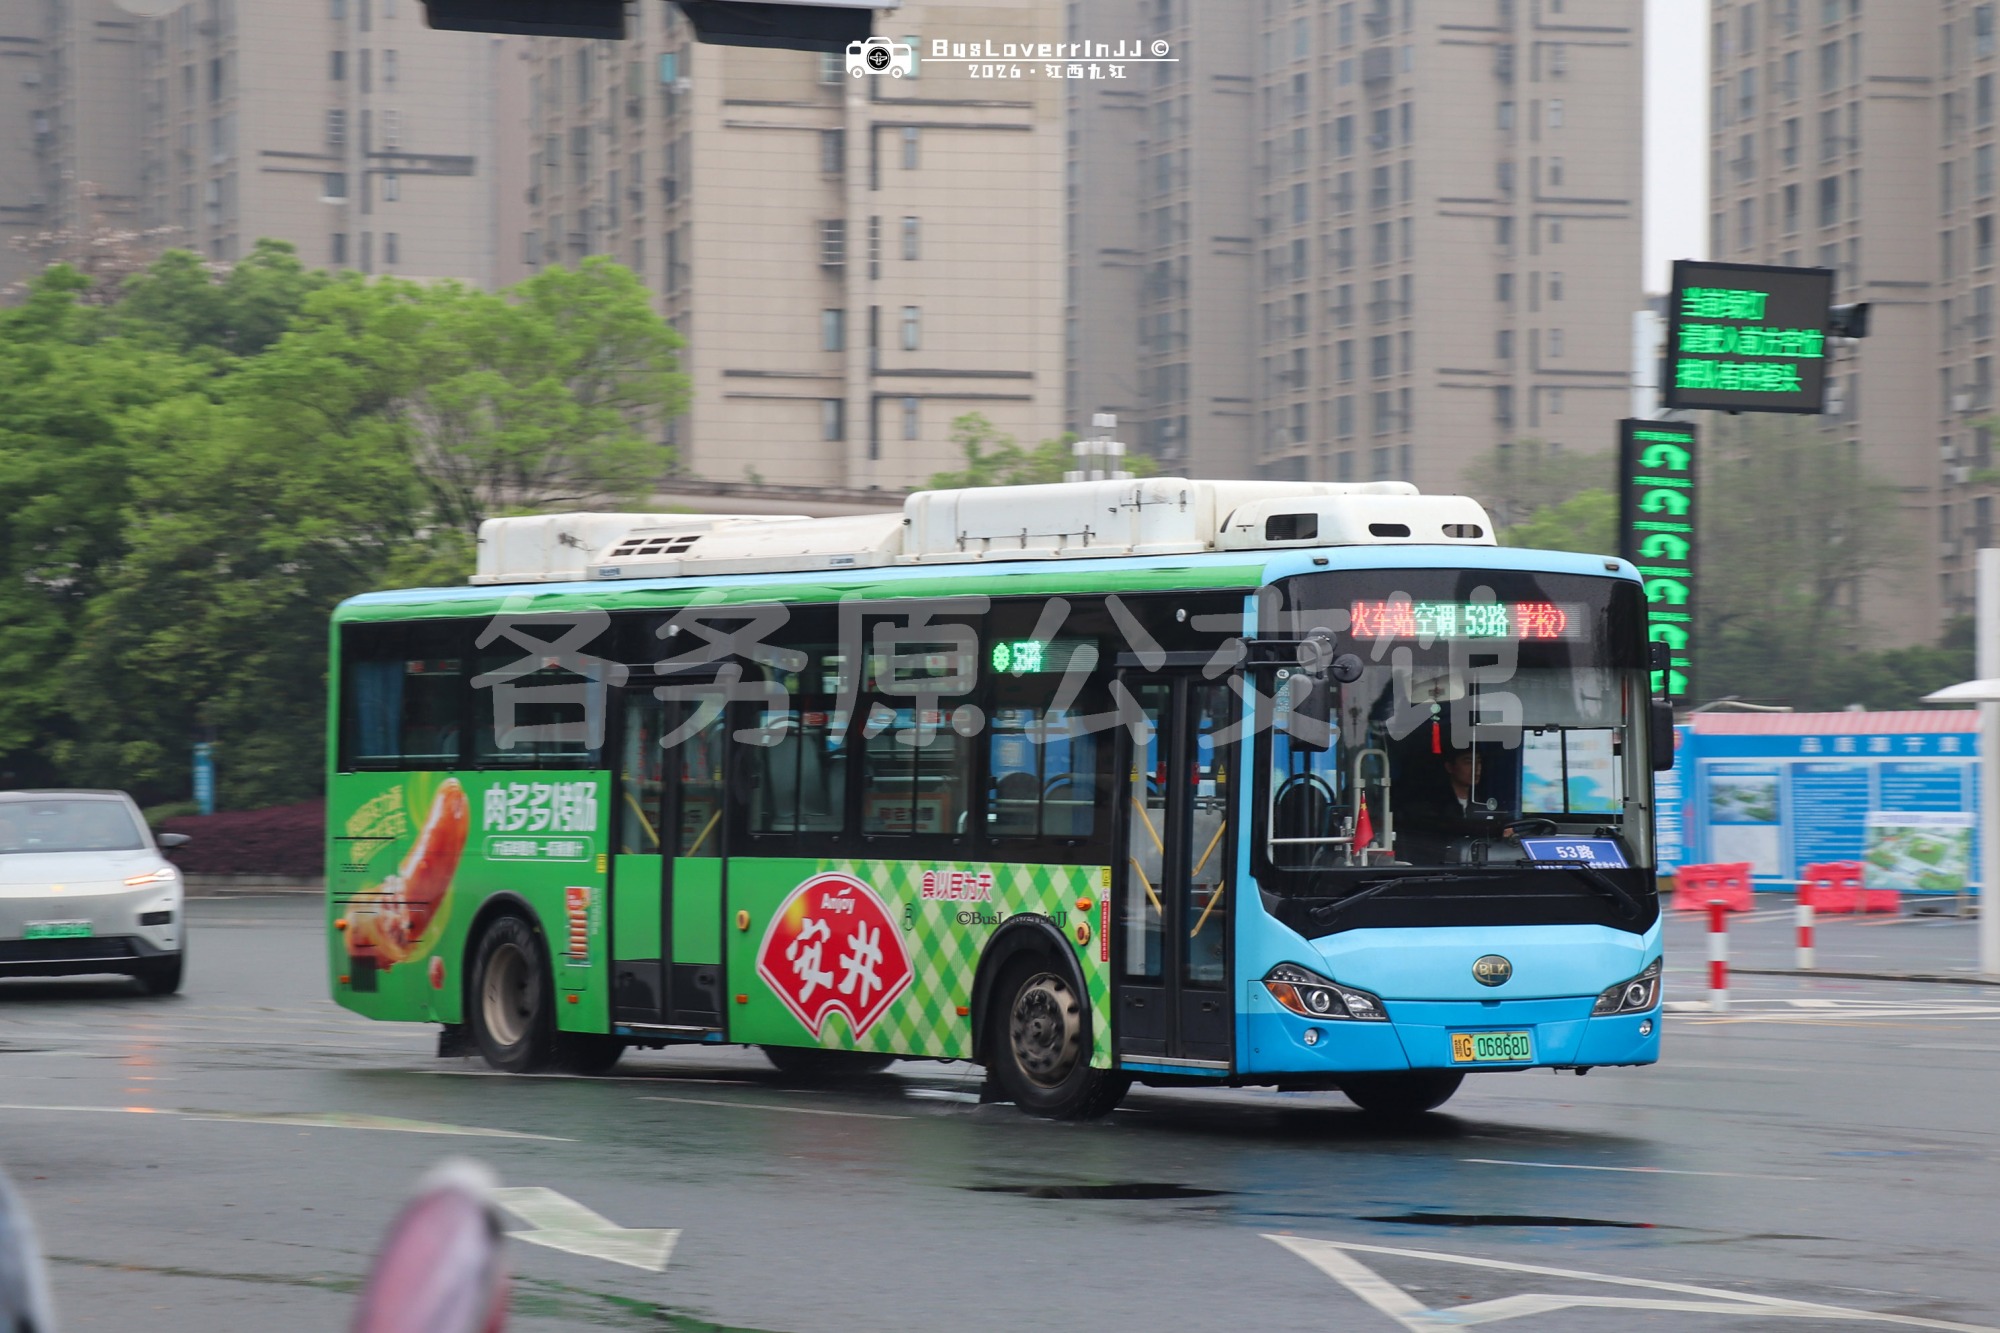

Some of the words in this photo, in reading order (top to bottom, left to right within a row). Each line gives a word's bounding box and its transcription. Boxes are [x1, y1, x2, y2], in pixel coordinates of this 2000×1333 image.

[1465, 603, 1508, 637] 53路
[1555, 845, 1596, 860] 53路
[921, 870, 992, 902] 食以民为天
[820, 888, 856, 915] Anjoy
[785, 917, 884, 1008] 安井
[1479, 963, 1506, 976] BLK
[1477, 1036, 1530, 1057] 06868D
